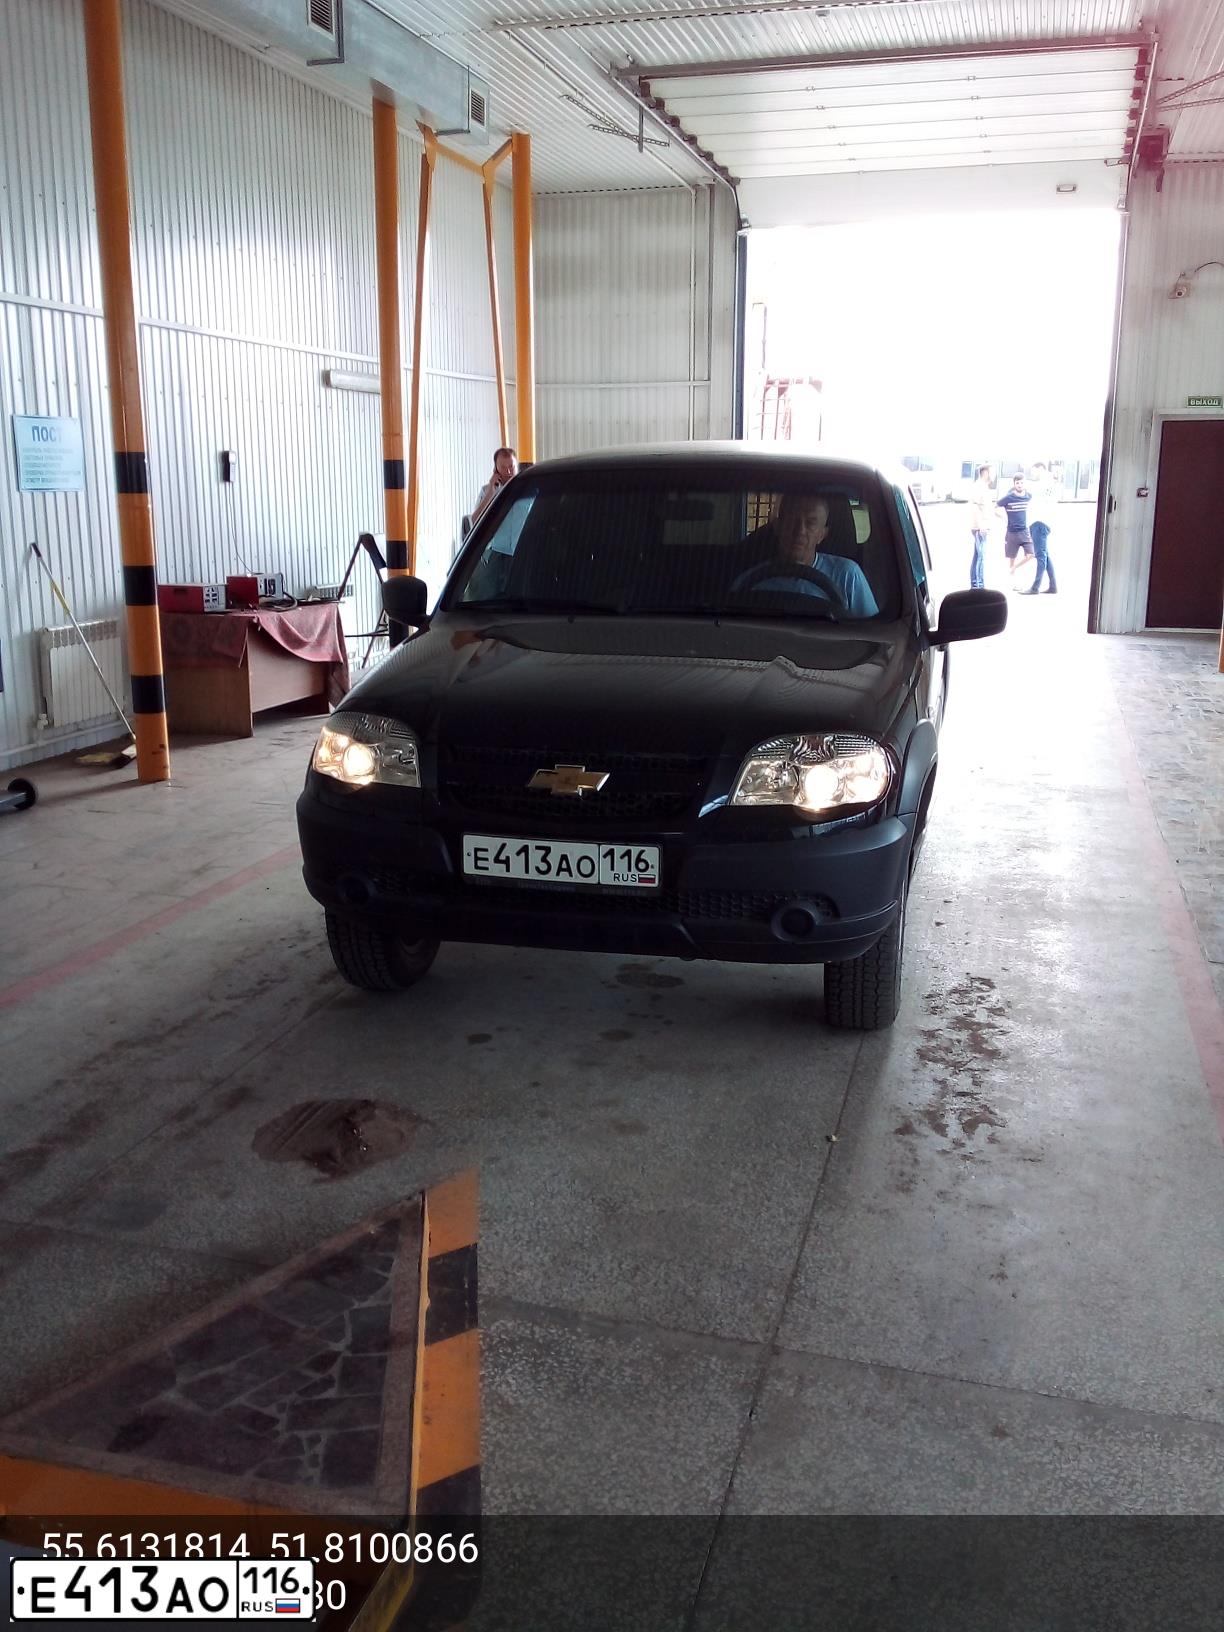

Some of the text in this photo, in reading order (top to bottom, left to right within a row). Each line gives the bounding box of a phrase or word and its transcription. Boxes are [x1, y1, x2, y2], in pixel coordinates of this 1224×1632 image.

[1190, 398, 1219, 406] ВЫХОД
[473, 842, 650, 879] E413AO 116
[613, 872, 638, 883] RUS
